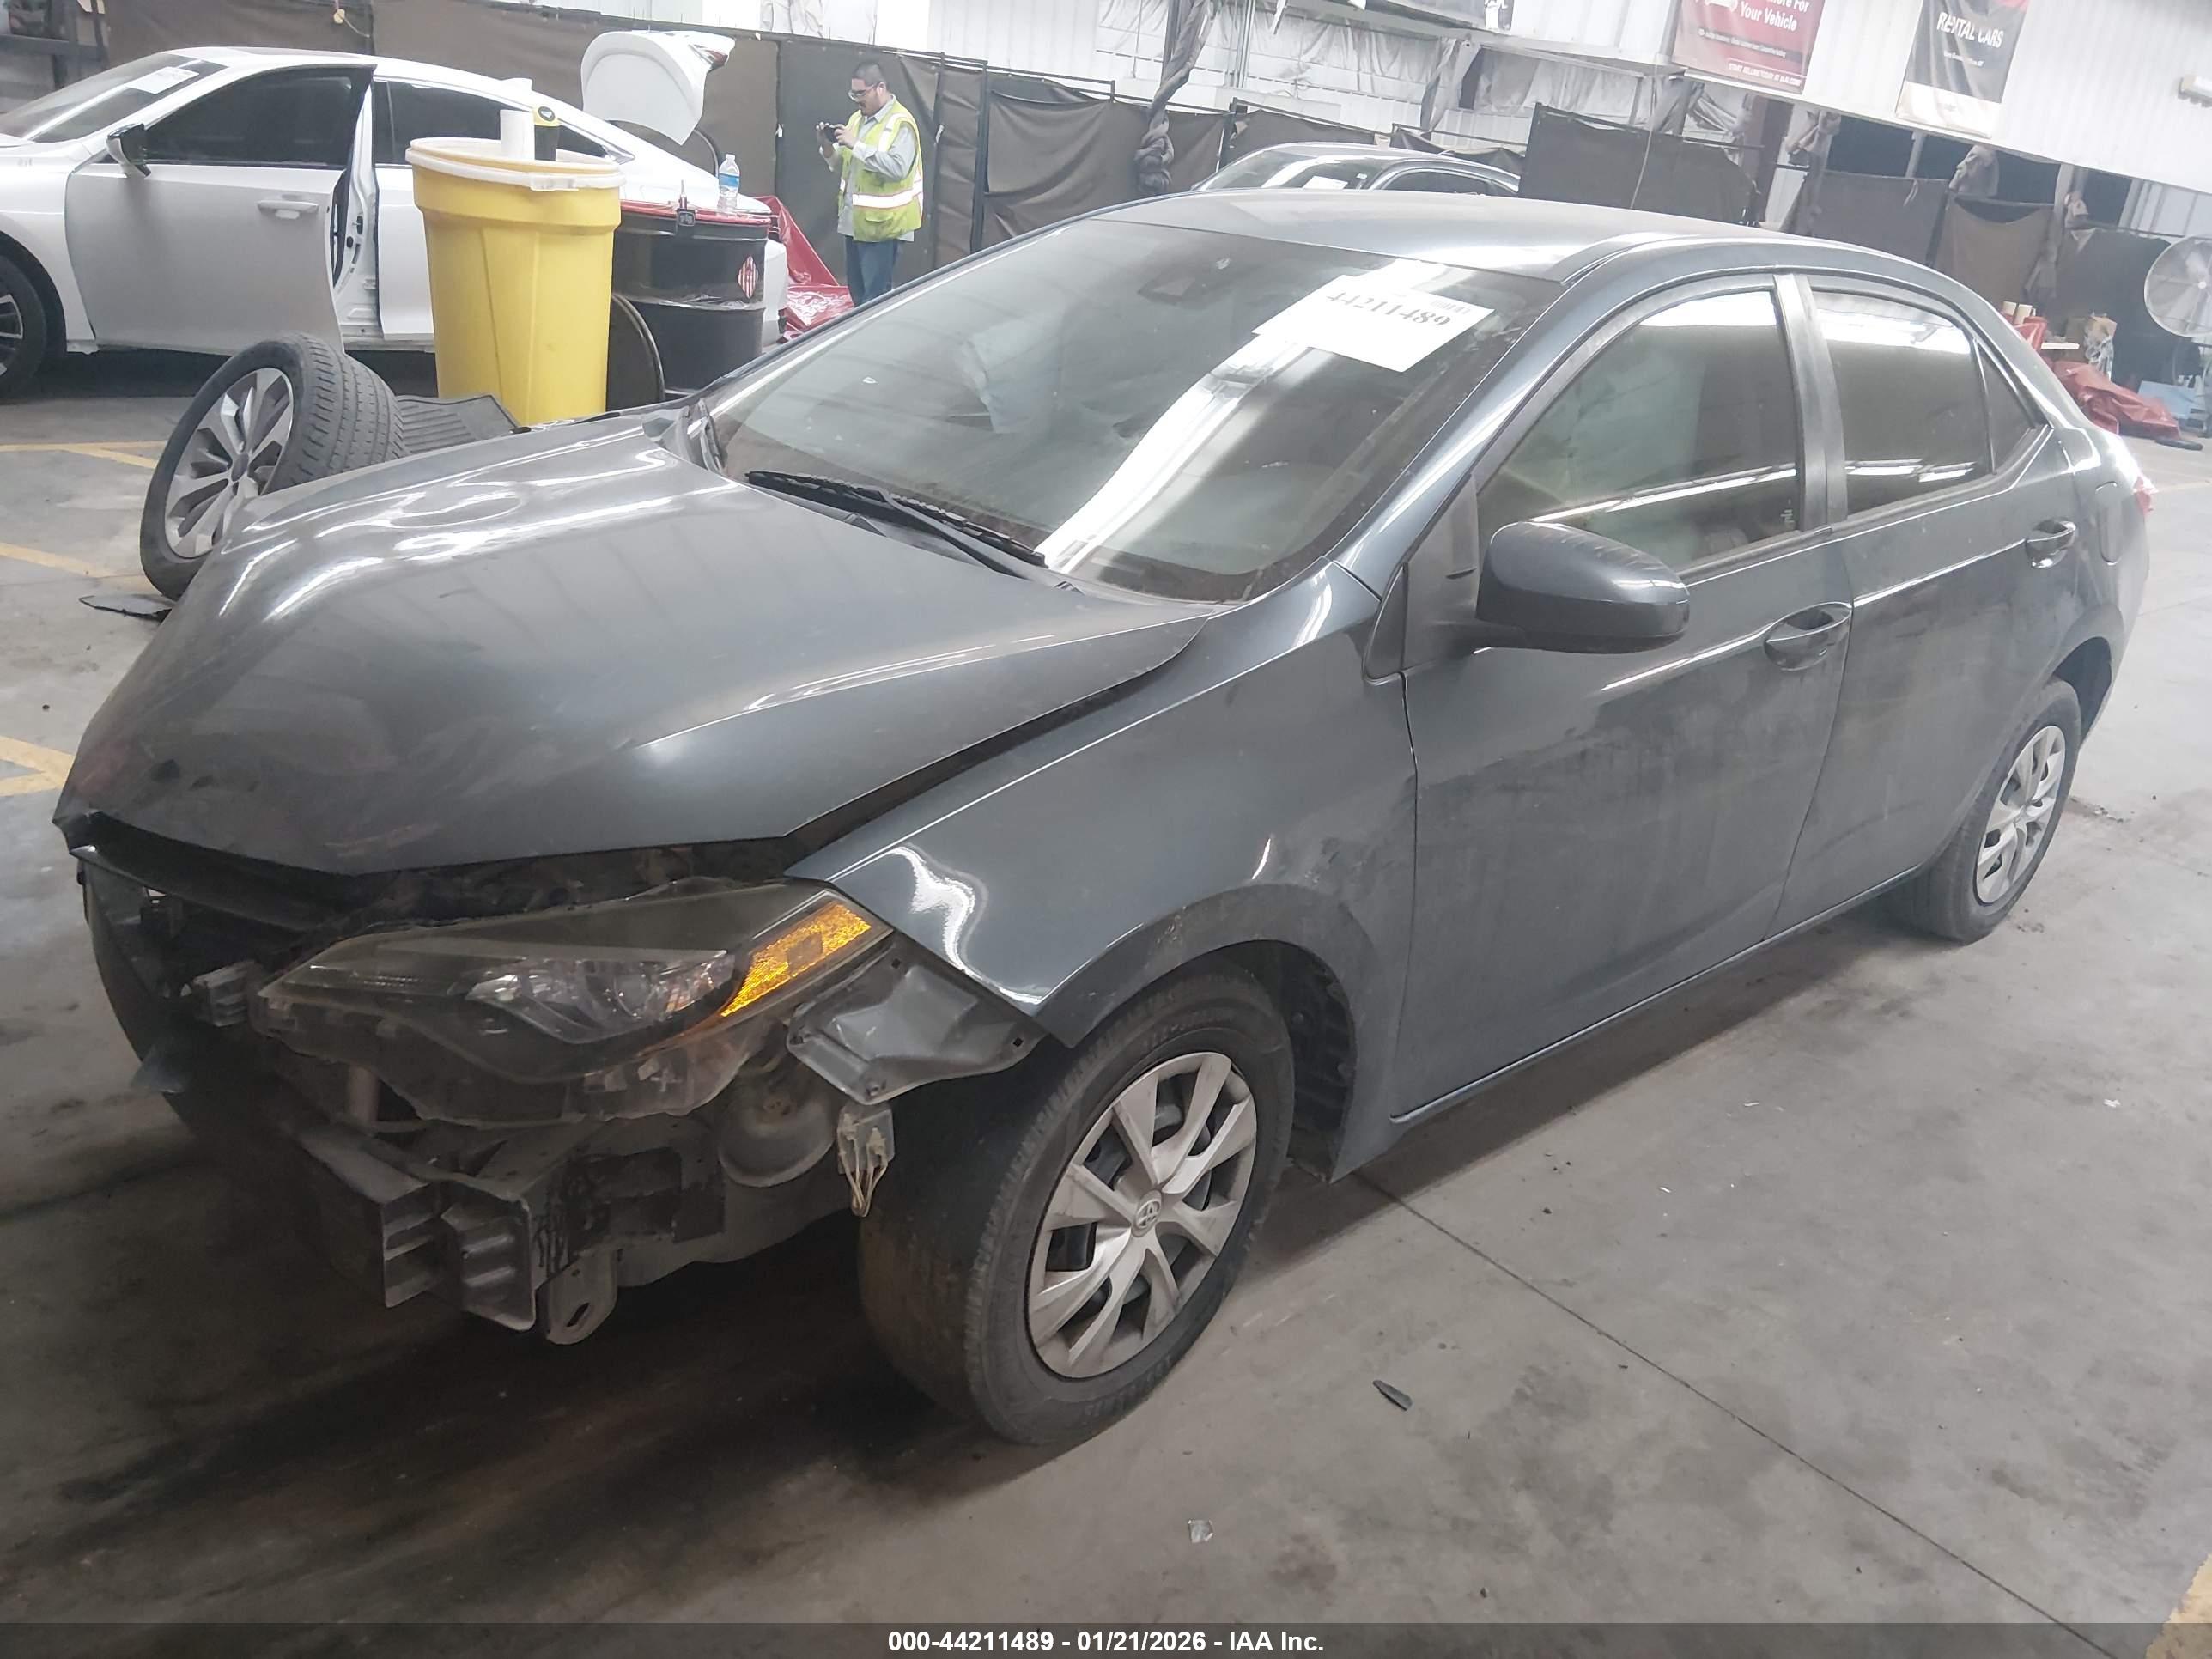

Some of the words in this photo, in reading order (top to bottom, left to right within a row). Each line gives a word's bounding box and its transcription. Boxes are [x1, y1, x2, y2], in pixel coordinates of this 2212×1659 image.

[1741, 1, 1763, 22] Your
[1764, 7, 1797, 32] Vehicle
[1936, 12, 1976, 41] RENTAL
[1978, 27, 2004, 49] CARS
[1326, 291, 1451, 326] 44211489
